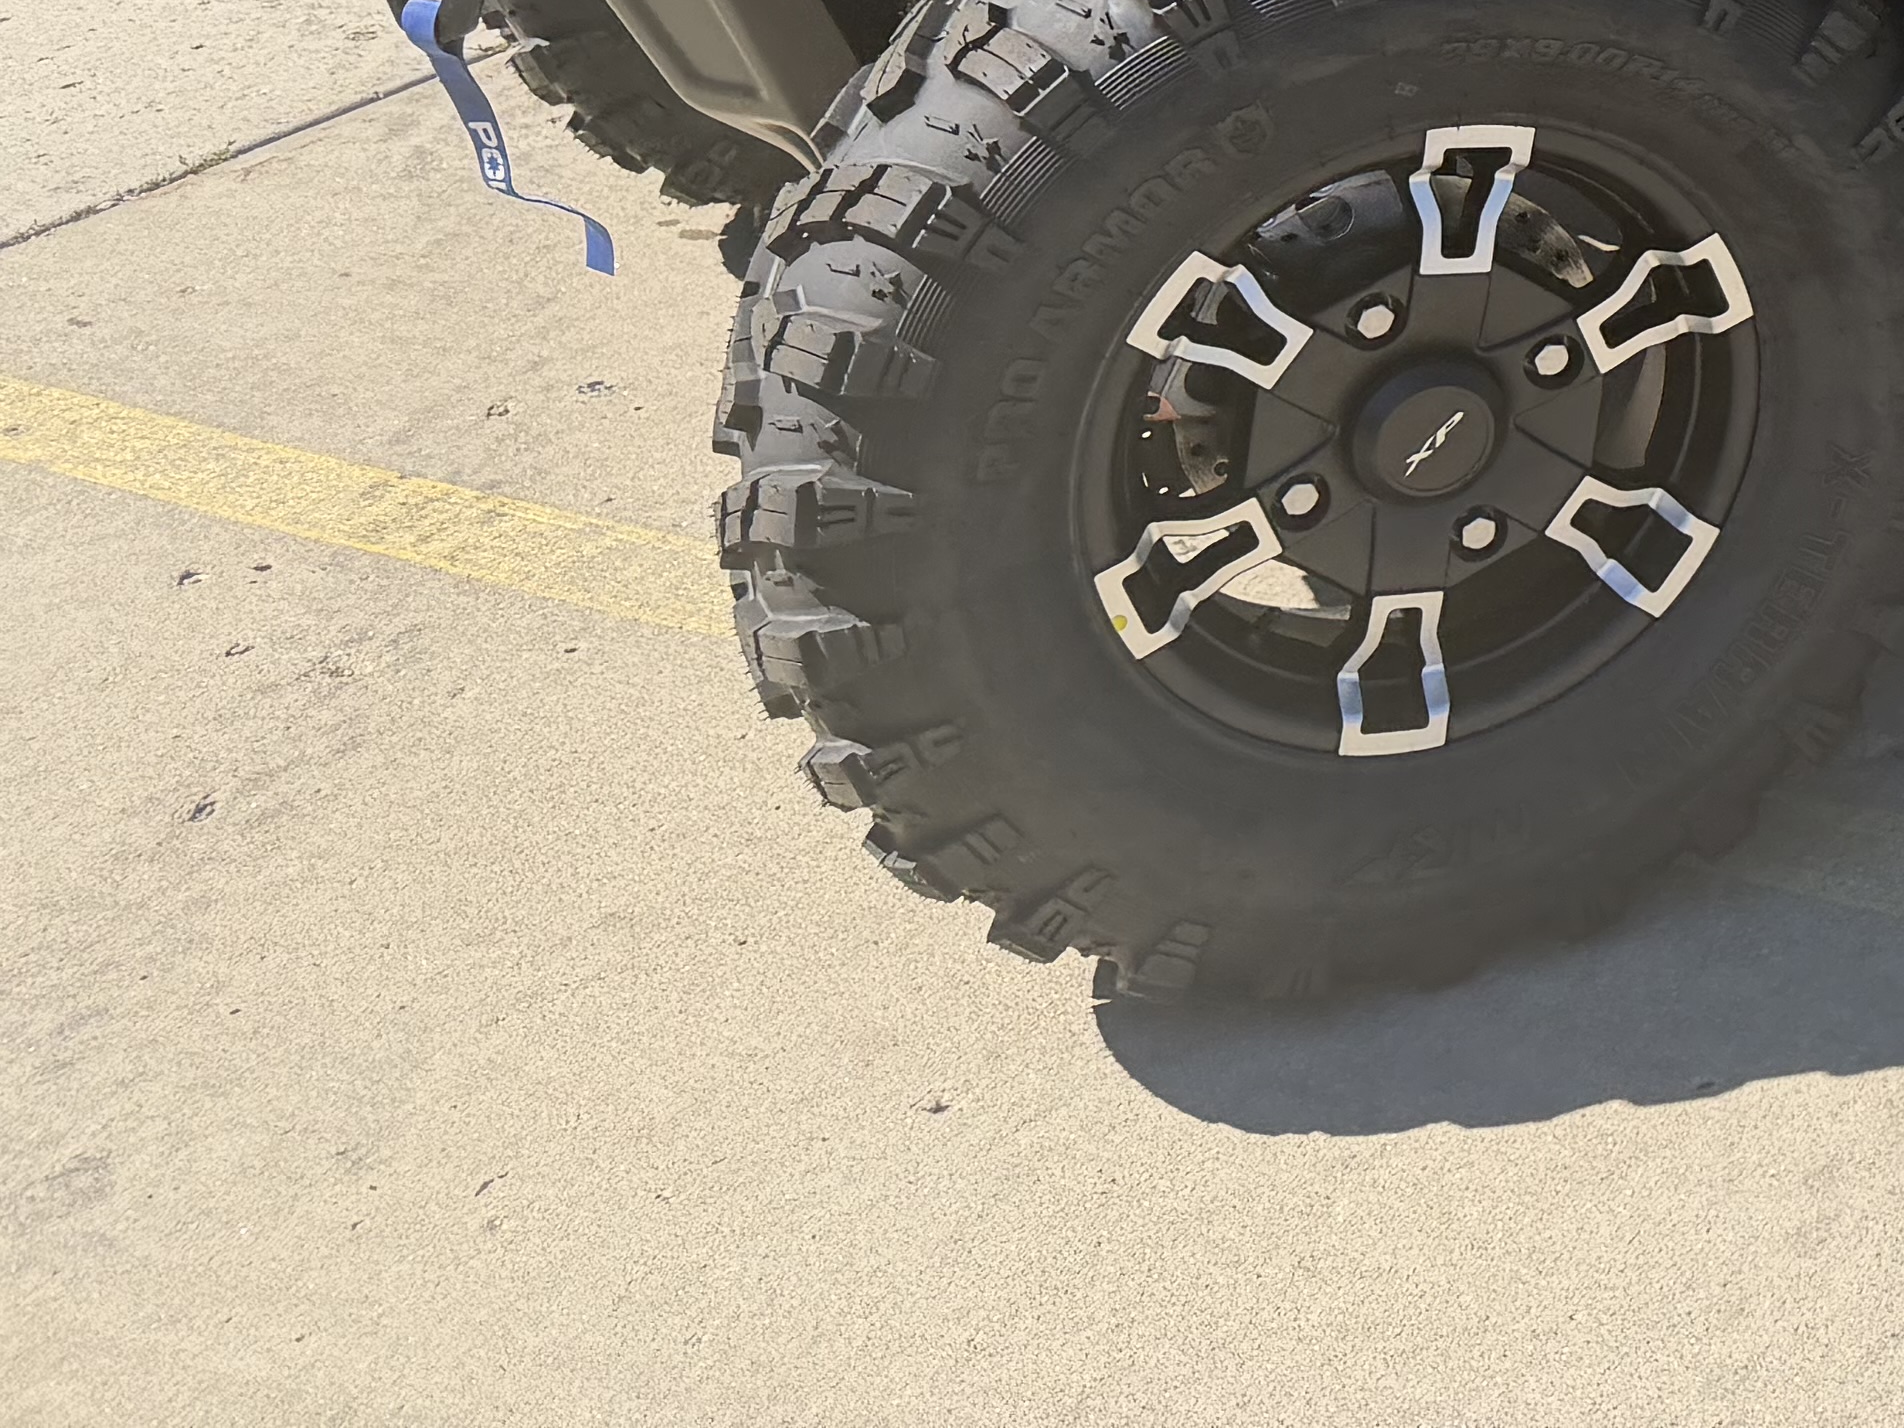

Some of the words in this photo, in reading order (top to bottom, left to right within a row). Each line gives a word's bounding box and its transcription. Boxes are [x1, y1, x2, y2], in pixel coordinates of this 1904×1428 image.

[976, 358, 1046, 486] PRO
[1027, 146, 1221, 344] ARMOR
[1403, 411, 1464, 479] XP
